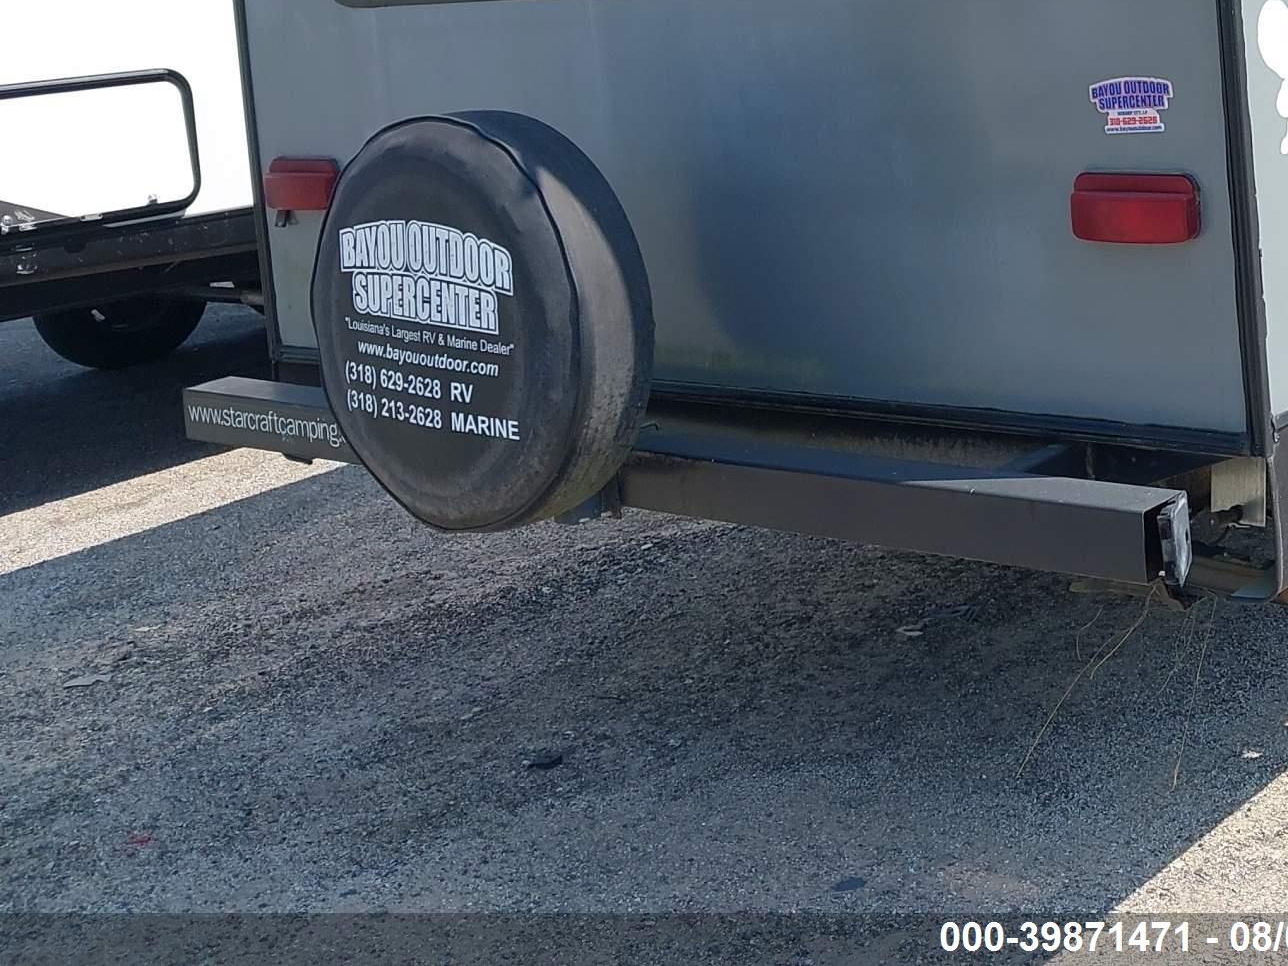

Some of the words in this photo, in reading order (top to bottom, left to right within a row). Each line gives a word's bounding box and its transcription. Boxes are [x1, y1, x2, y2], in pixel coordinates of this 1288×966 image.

[1091, 81, 1122, 99] BAYOU
[1123, 79, 1169, 96] OUTDOOR
[1099, 95, 1165, 110] SUPERCENTER
[340, 221, 406, 271] BAYOU
[407, 221, 513, 294] OUTDOOR
[353, 272, 498, 333] SUPERCENTER
[345, 317, 390, 336] "Louisiana's
[391, 325, 421, 343] Largest
[422, 331, 437, 345] RV
[438, 333, 446, 346] &
[447, 335, 478, 351] Marine
[480, 339, 515, 356] Dealer"
[358, 341, 499, 377] www.bayououtdoor.com
[345, 361, 377, 390] (318)
[380, 368, 442, 399] 629-2628
[450, 382, 474, 404] RV
[188, 405, 347, 447] www.starcraftcamping.
[347, 389, 378, 418] (318)
[381, 398, 443, 429] 213-2628
[451, 412, 521, 441] MARINE
